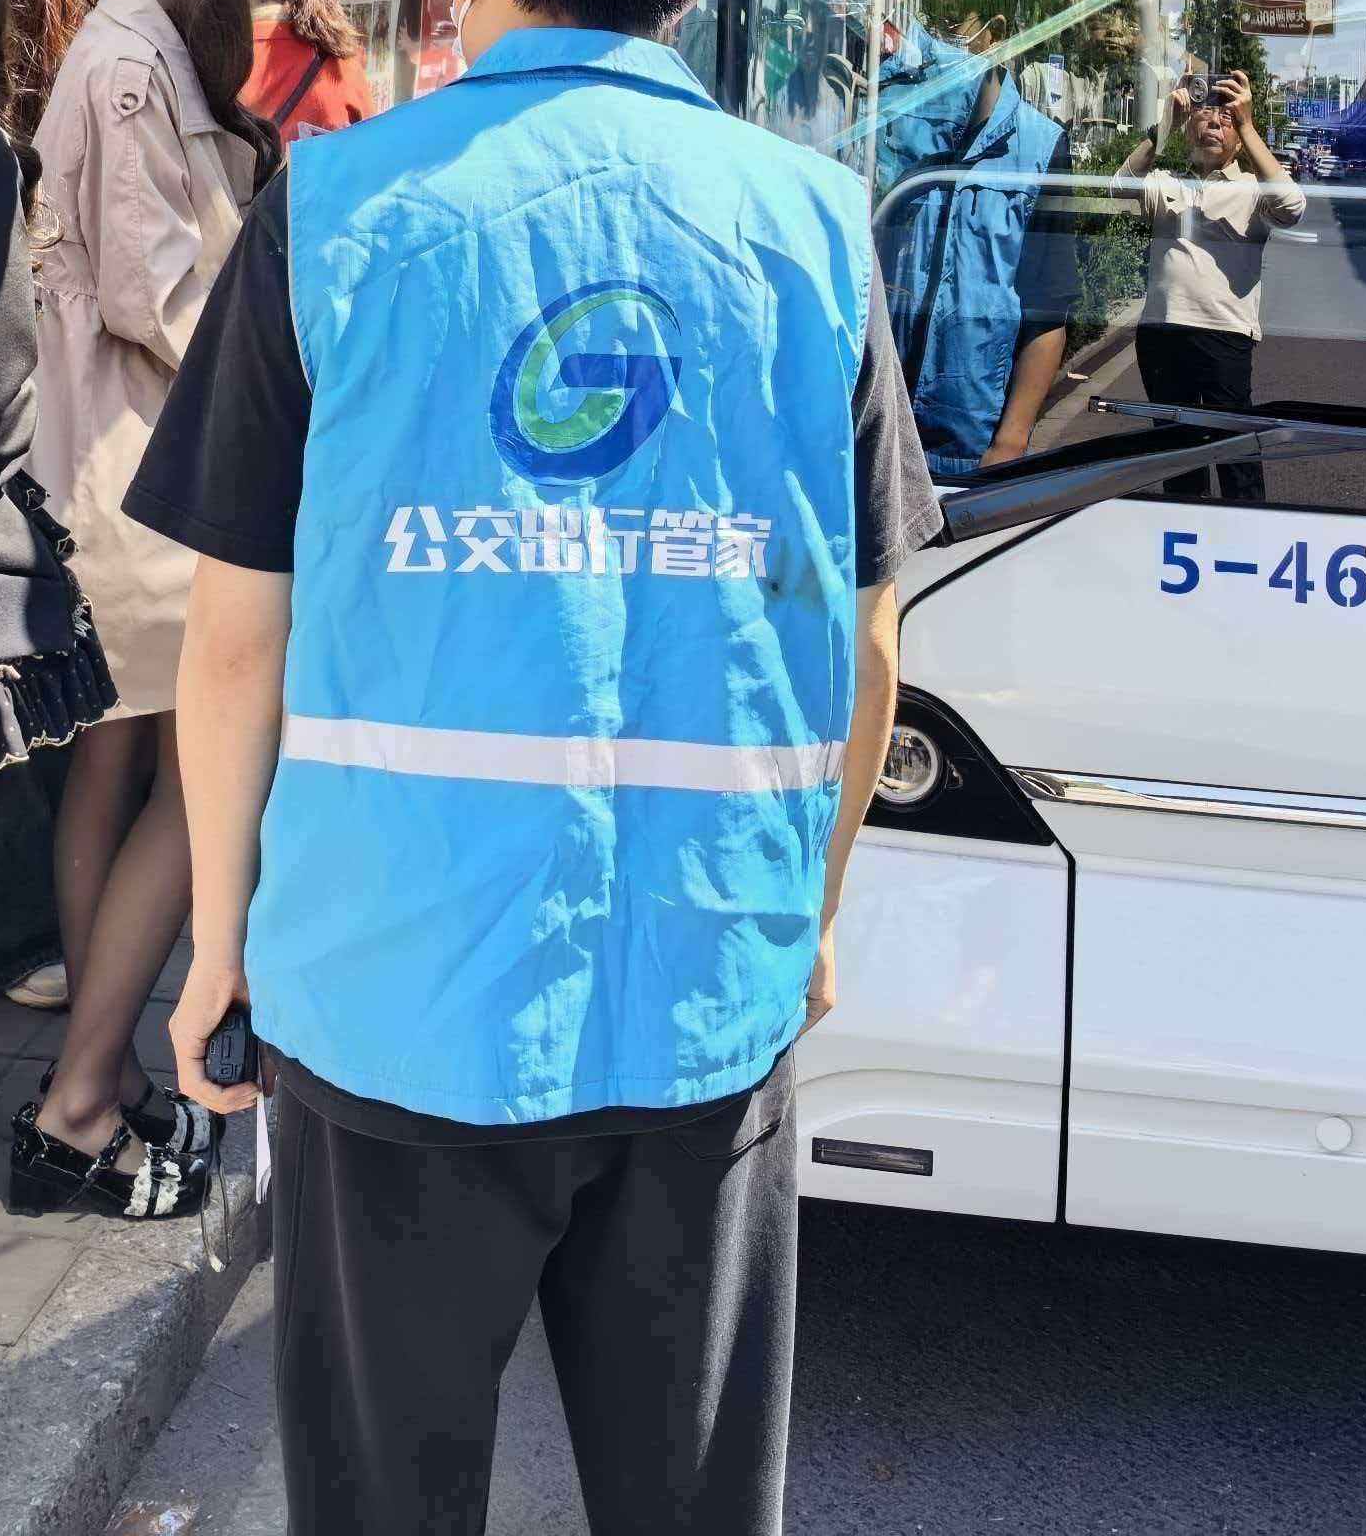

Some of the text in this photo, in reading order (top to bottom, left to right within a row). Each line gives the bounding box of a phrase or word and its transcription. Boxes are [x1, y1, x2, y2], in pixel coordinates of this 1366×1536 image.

[384, 505, 772, 578] 公交出行管家
